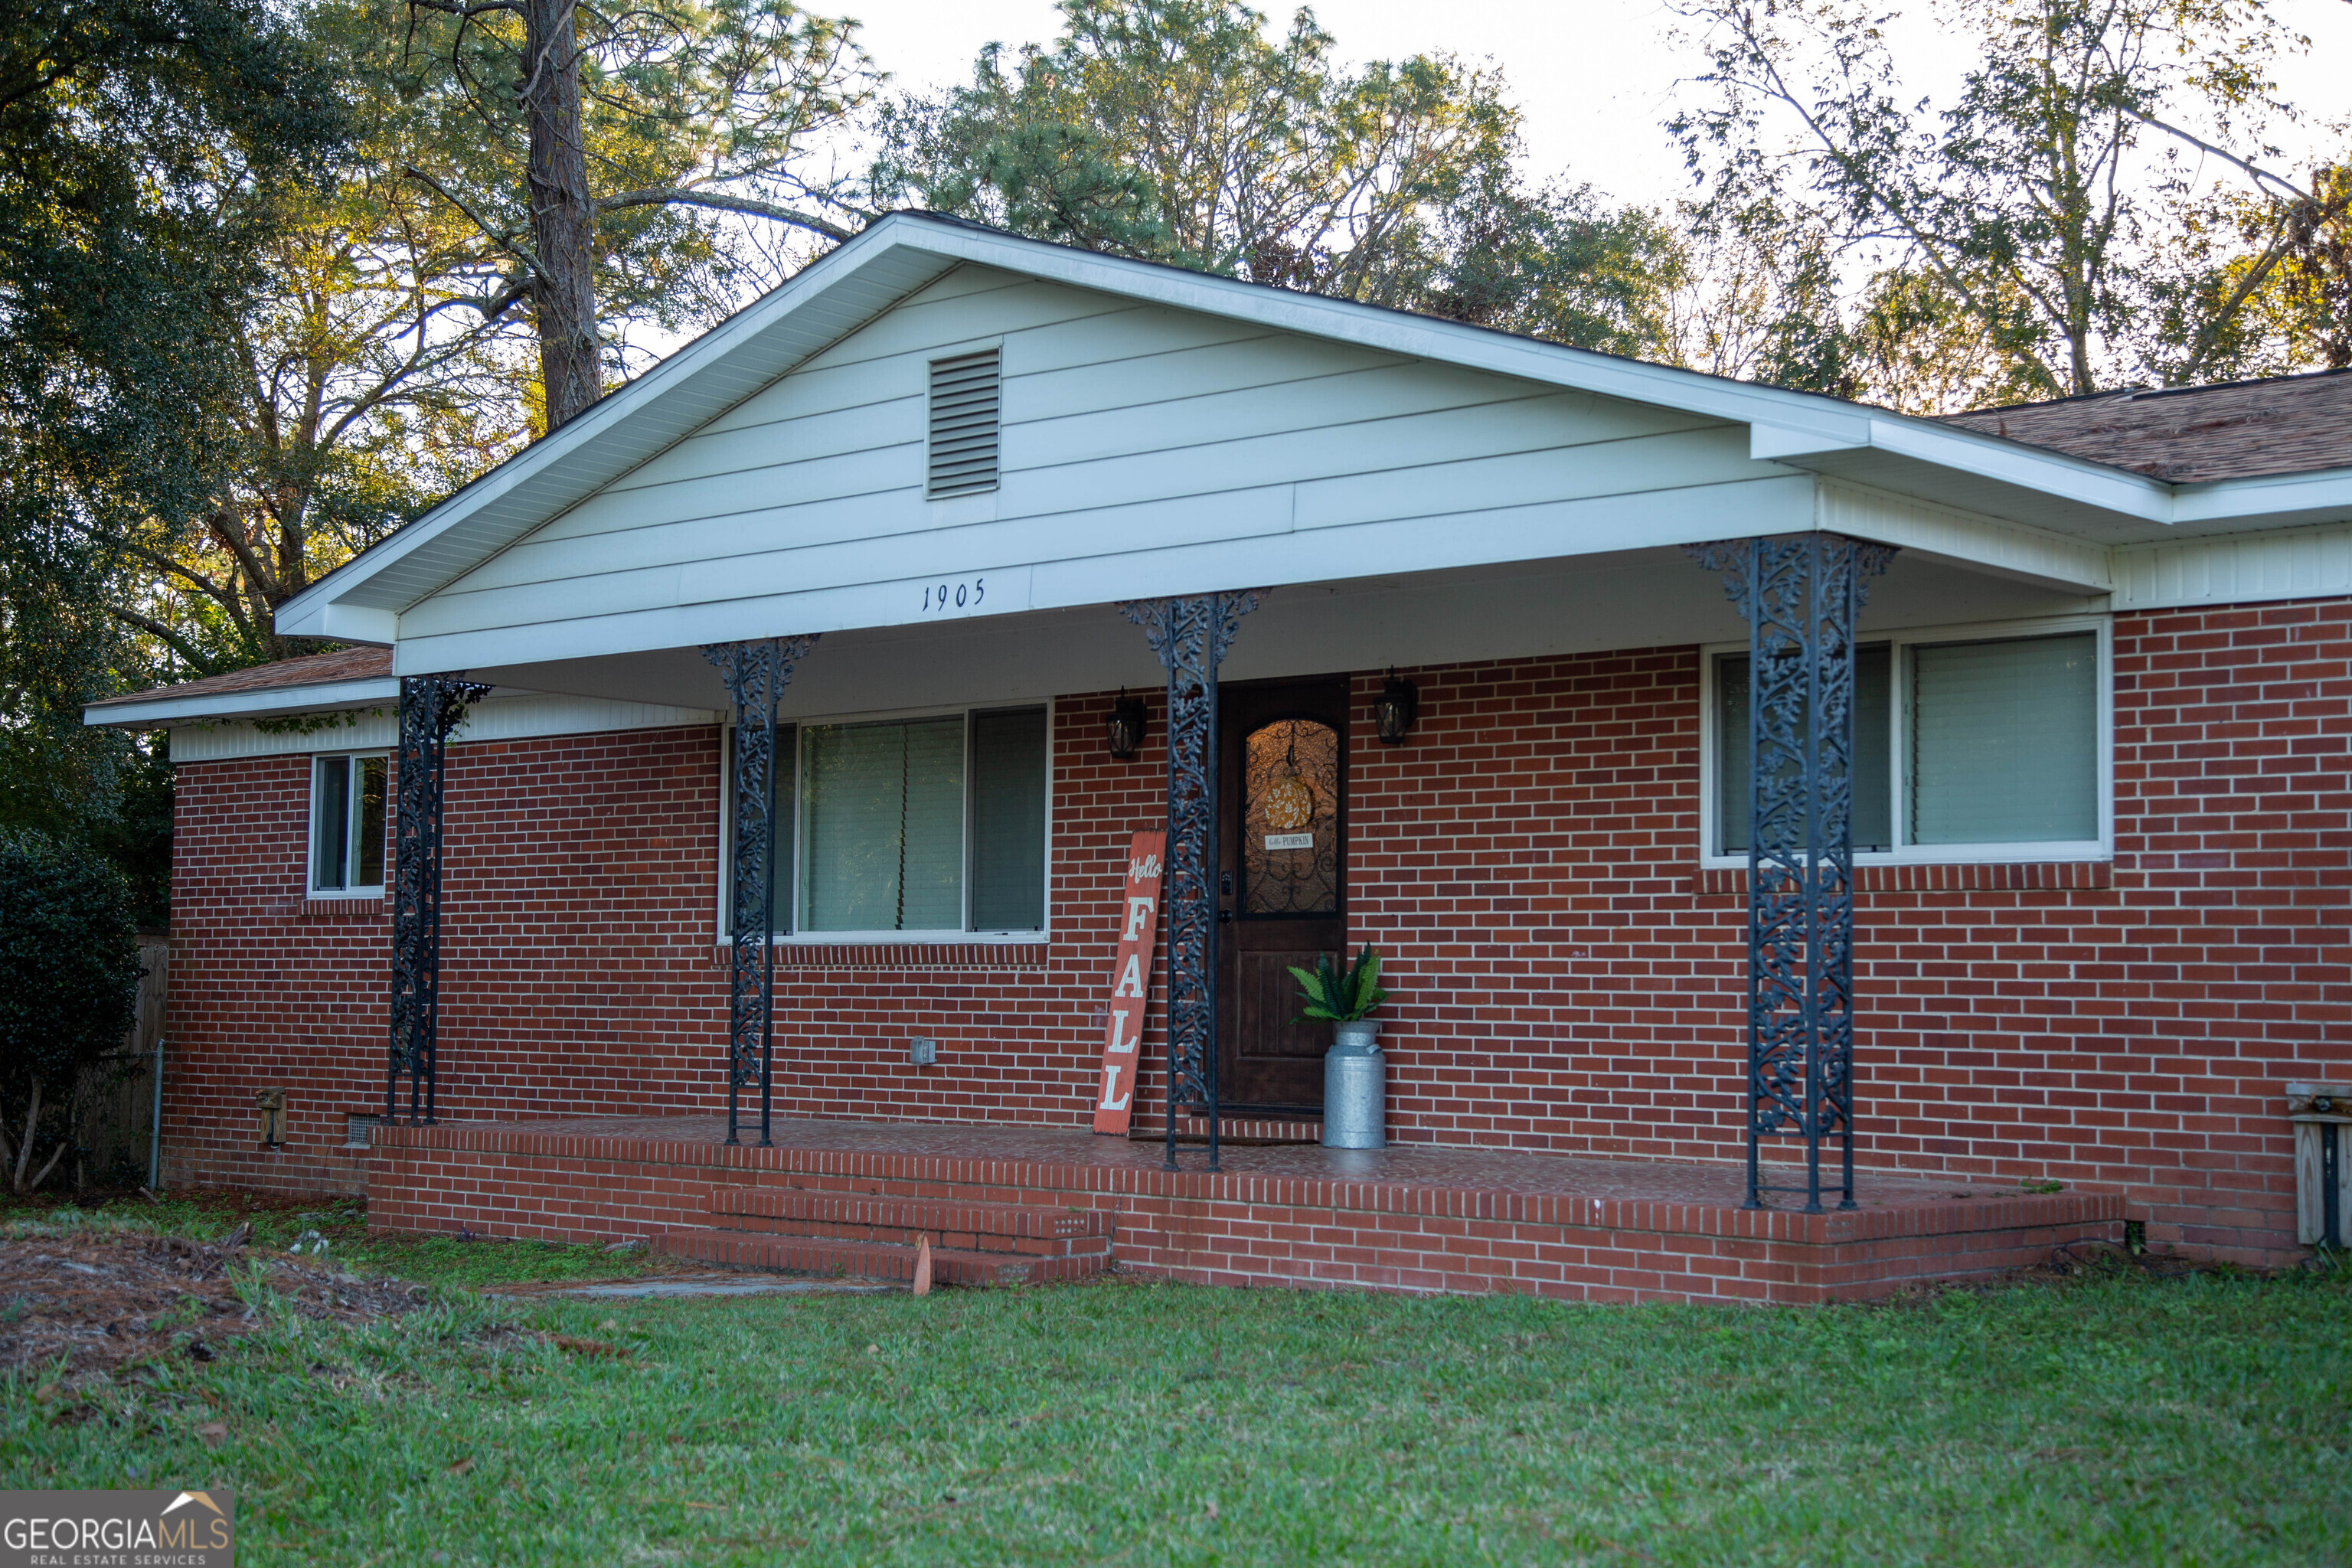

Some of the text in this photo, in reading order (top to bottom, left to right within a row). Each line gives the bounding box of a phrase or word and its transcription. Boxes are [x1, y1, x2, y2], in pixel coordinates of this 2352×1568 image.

[923, 578, 984, 612] 1905
[1129, 854, 1163, 884] Hello
[1099, 897, 1155, 1110] FALL
